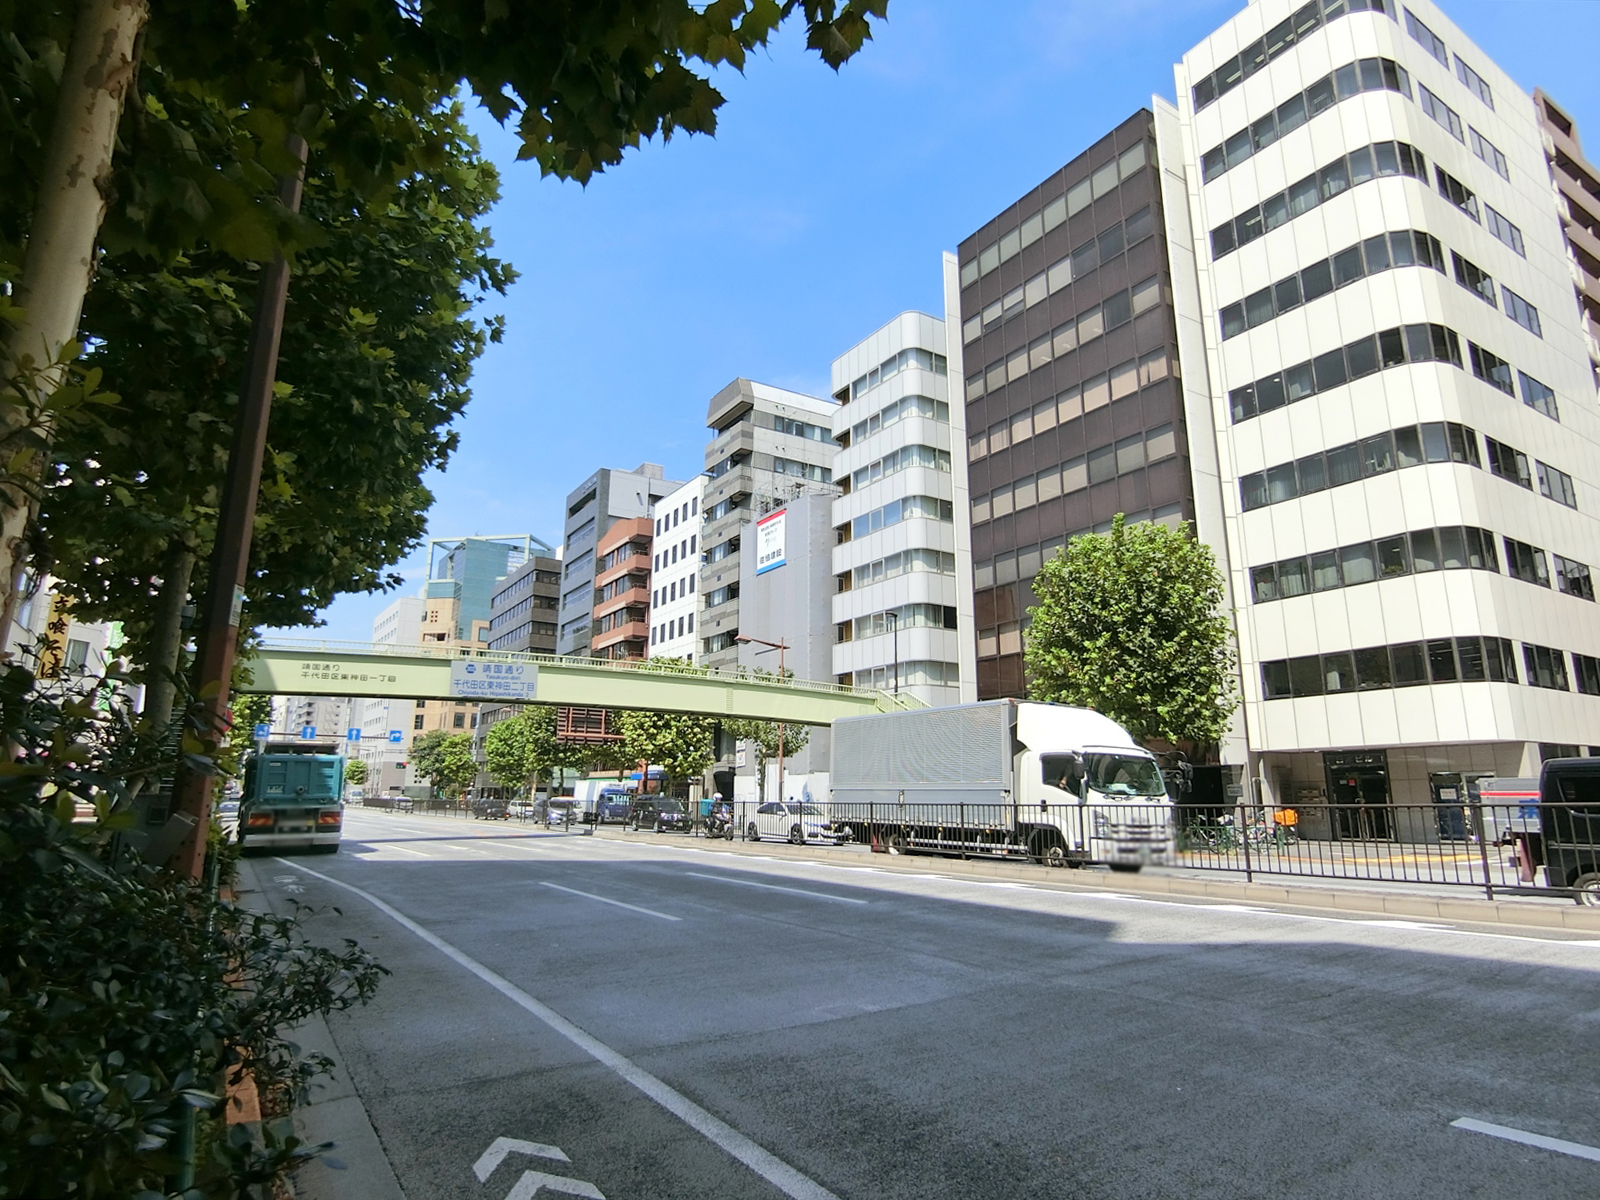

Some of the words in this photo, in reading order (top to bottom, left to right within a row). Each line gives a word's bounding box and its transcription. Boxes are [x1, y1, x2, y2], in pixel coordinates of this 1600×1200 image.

[301, 663, 340, 671] 靖国通り
[482, 664, 524, 675] 靖国通り
[301, 671, 397, 682] 千代田区東神田一丁目
[453, 679, 535, 691] 千代田区東神田二丁目
[458, 689, 488, 697] Chiyoda-ku
